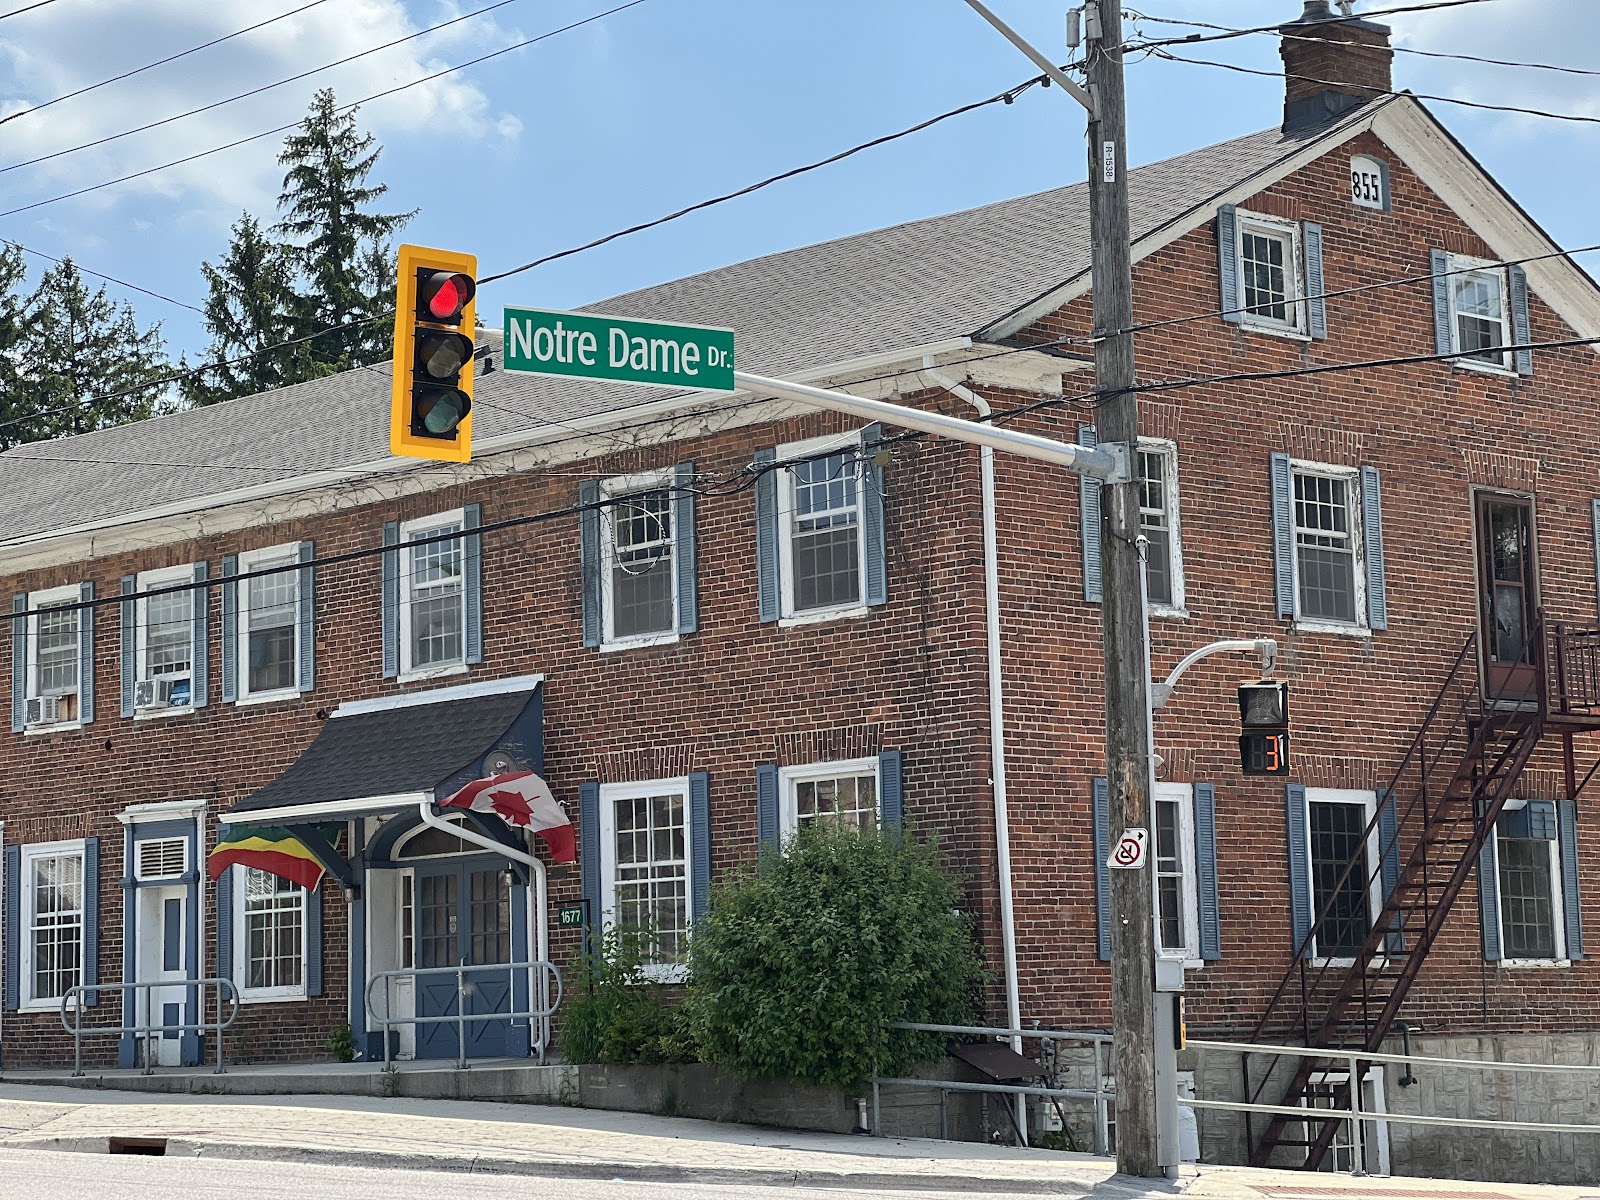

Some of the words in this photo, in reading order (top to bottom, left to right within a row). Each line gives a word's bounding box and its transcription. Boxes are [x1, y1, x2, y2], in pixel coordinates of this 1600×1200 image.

[1105, 146, 1113, 177] R-1538
[1352, 171, 1379, 201] 855
[509, 317, 597, 366] Notre
[609, 327, 700, 376] Dame
[707, 346, 731, 369] Dr.
[1266, 735, 1279, 771] 3
[560, 910, 581, 924] 1677
